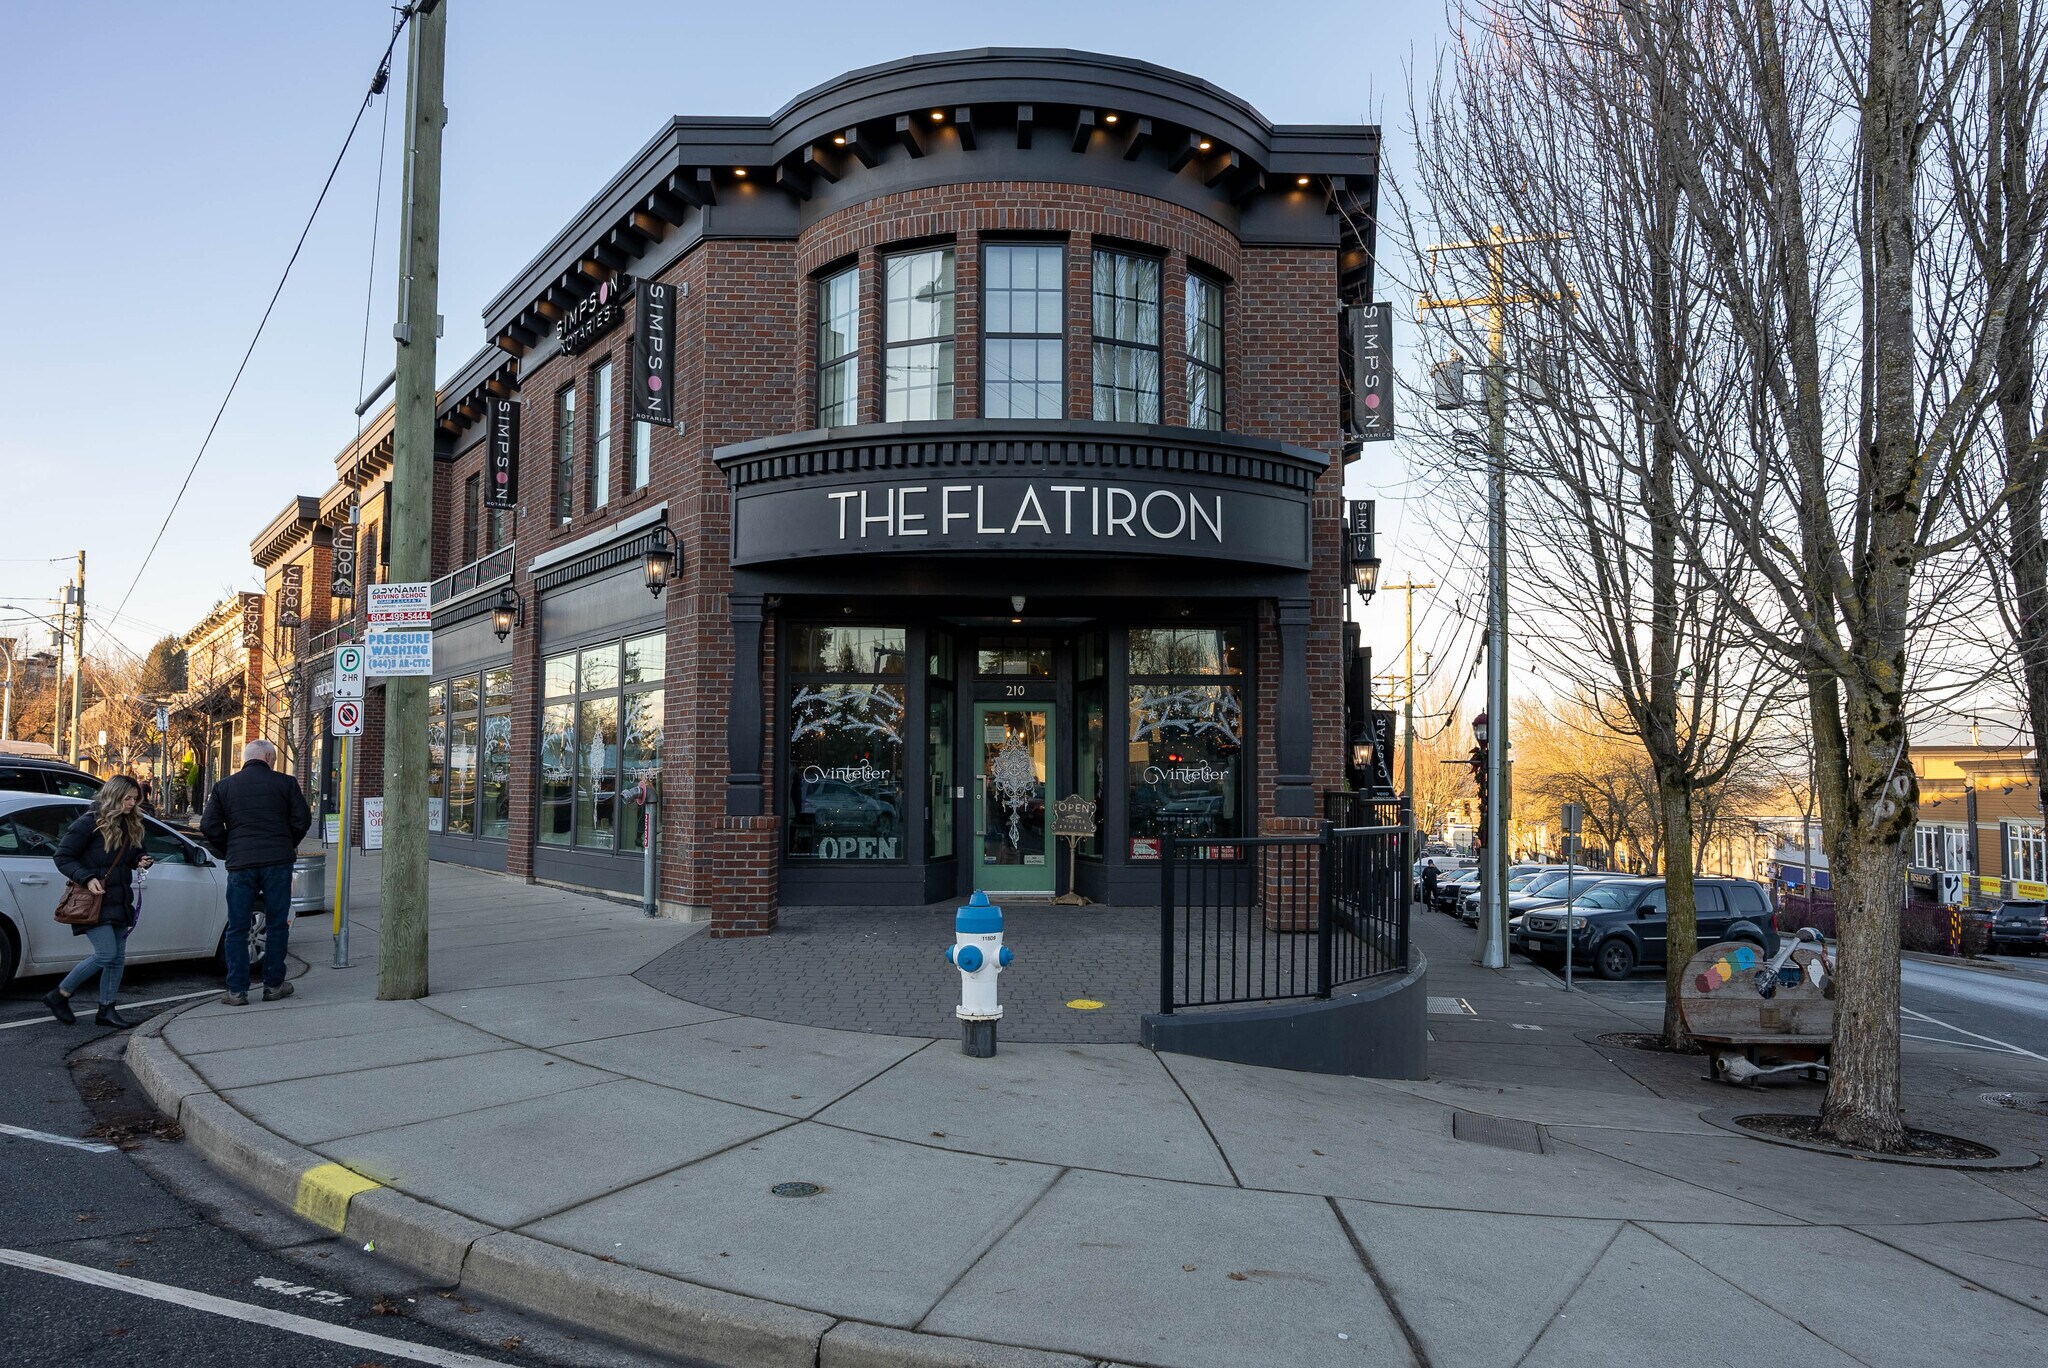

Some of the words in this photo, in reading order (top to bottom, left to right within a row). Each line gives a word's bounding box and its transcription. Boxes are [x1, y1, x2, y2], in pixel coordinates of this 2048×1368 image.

[561, 305, 611, 354] NOTARIES
[636, 413, 672, 423] NOTARIES
[828, 486, 928, 540] THE
[942, 484, 1222, 544] FLATIRON
[282, 566, 303, 608] vybe
[370, 612, 428, 622] 604-499-5444
[368, 633, 430, 645] PRESSURE
[371, 645, 428, 655] WASHING
[346, 654, 356, 667] P
[368, 659, 396, 669] (844)5
[399, 658, 431, 668] AR-CTIC
[1006, 685, 1025, 696] 210
[1059, 803, 1090, 813] OPEN
[818, 837, 897, 859] OPEN
